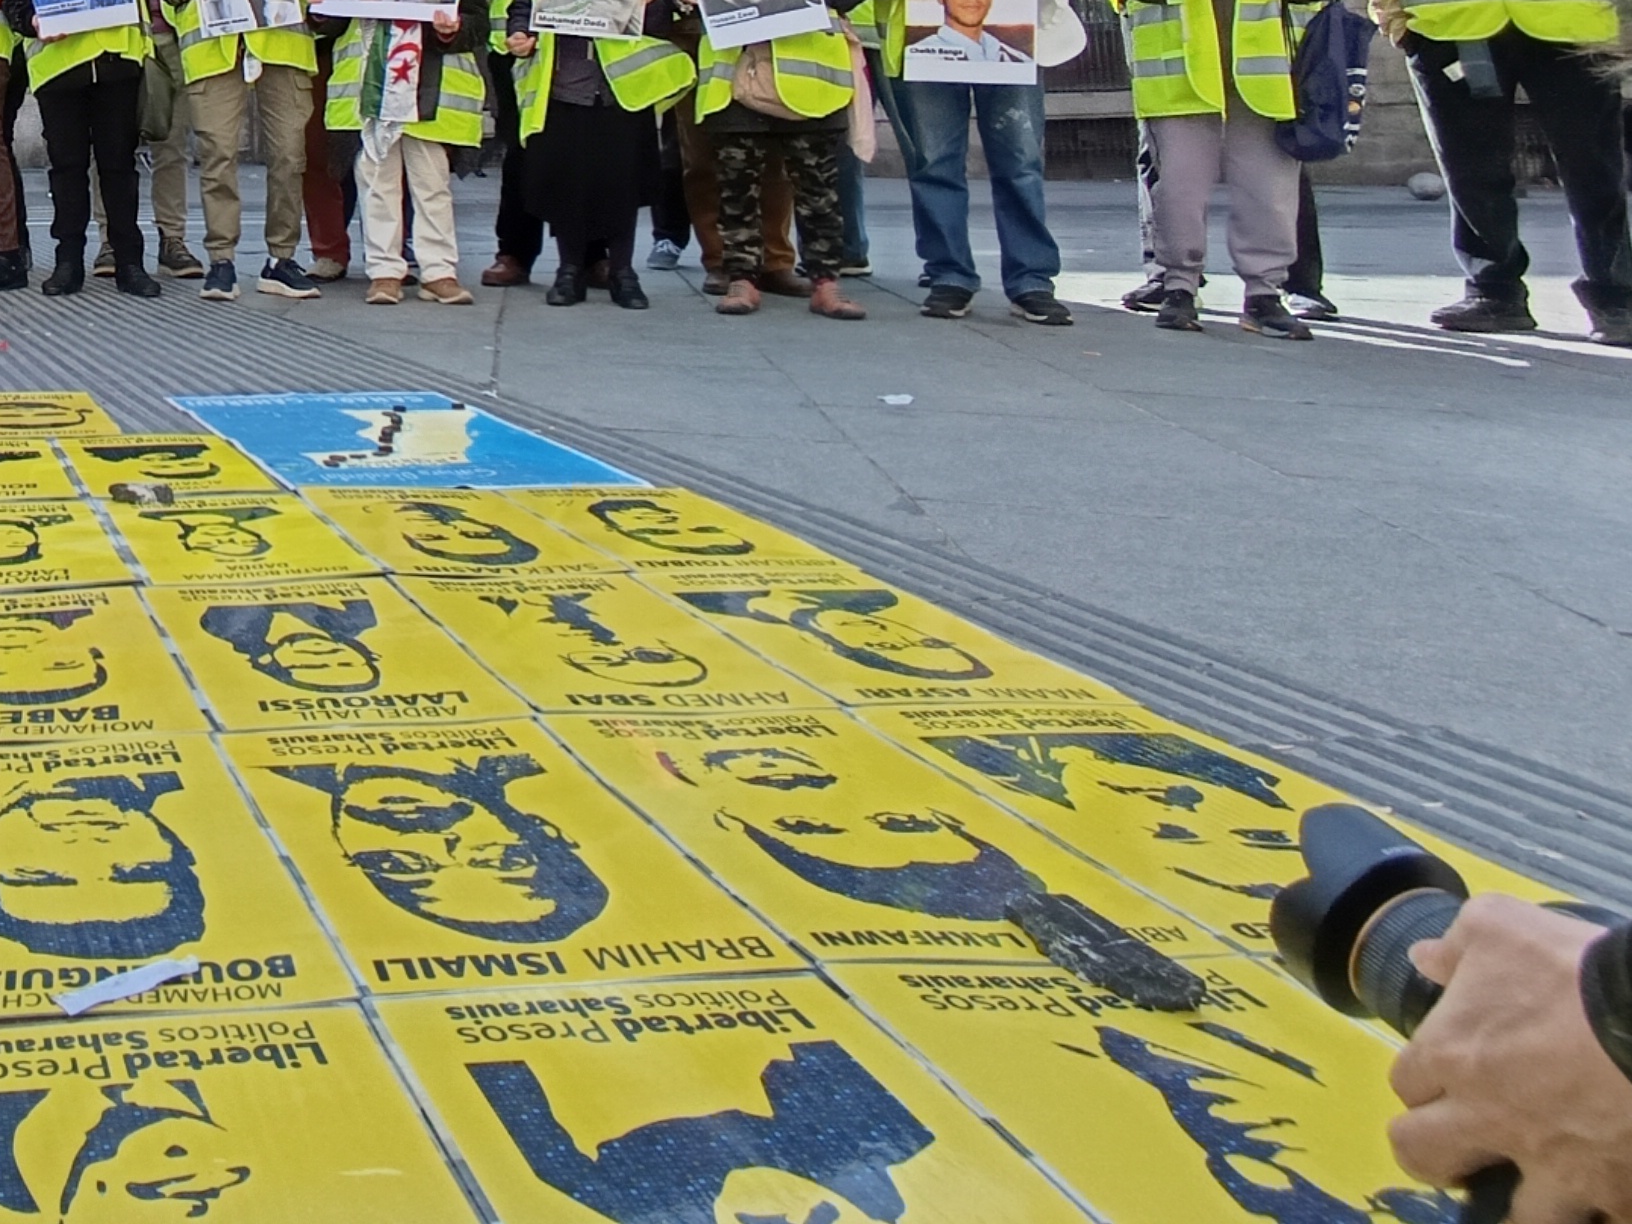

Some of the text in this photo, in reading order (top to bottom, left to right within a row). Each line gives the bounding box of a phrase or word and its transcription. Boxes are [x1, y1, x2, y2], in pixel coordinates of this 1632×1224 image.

[538, 14, 581, 25] Mohamed
[633, 558, 730, 567] TOUBALI
[257, 691, 469, 712] LAAROUSSI
[563, 690, 790, 708] AHMED SBAI
[854, 686, 1096, 700] NAAMA ASFARI
[292, 704, 458, 721] ABDEL JALIL
[588, 713, 821, 729] Políticos Saharauis
[11, 719, 154, 735] MOHAMED
[266, 726, 506, 747] Políticos Saharauis
[597, 724, 837, 741] Libertad Presos
[66, 739, 176, 755] Políticos
[271, 737, 517, 757] Libertad Presos
[42, 750, 182, 773] Libertad
[810, 928, 1026, 950] LAKHFAWNI
[372, 934, 774, 982] BRAHIM ISMAILI
[126, 982, 282, 1005] MOHAMED
[920, 982, 1268, 1019] Libad Presos
[445, 988, 791, 1024] Políticos Saharauis
[154, 1020, 315, 1046] Políticos
[455, 1006, 815, 1044] Libertad Presos
[123, 1041, 327, 1078] Libertad
